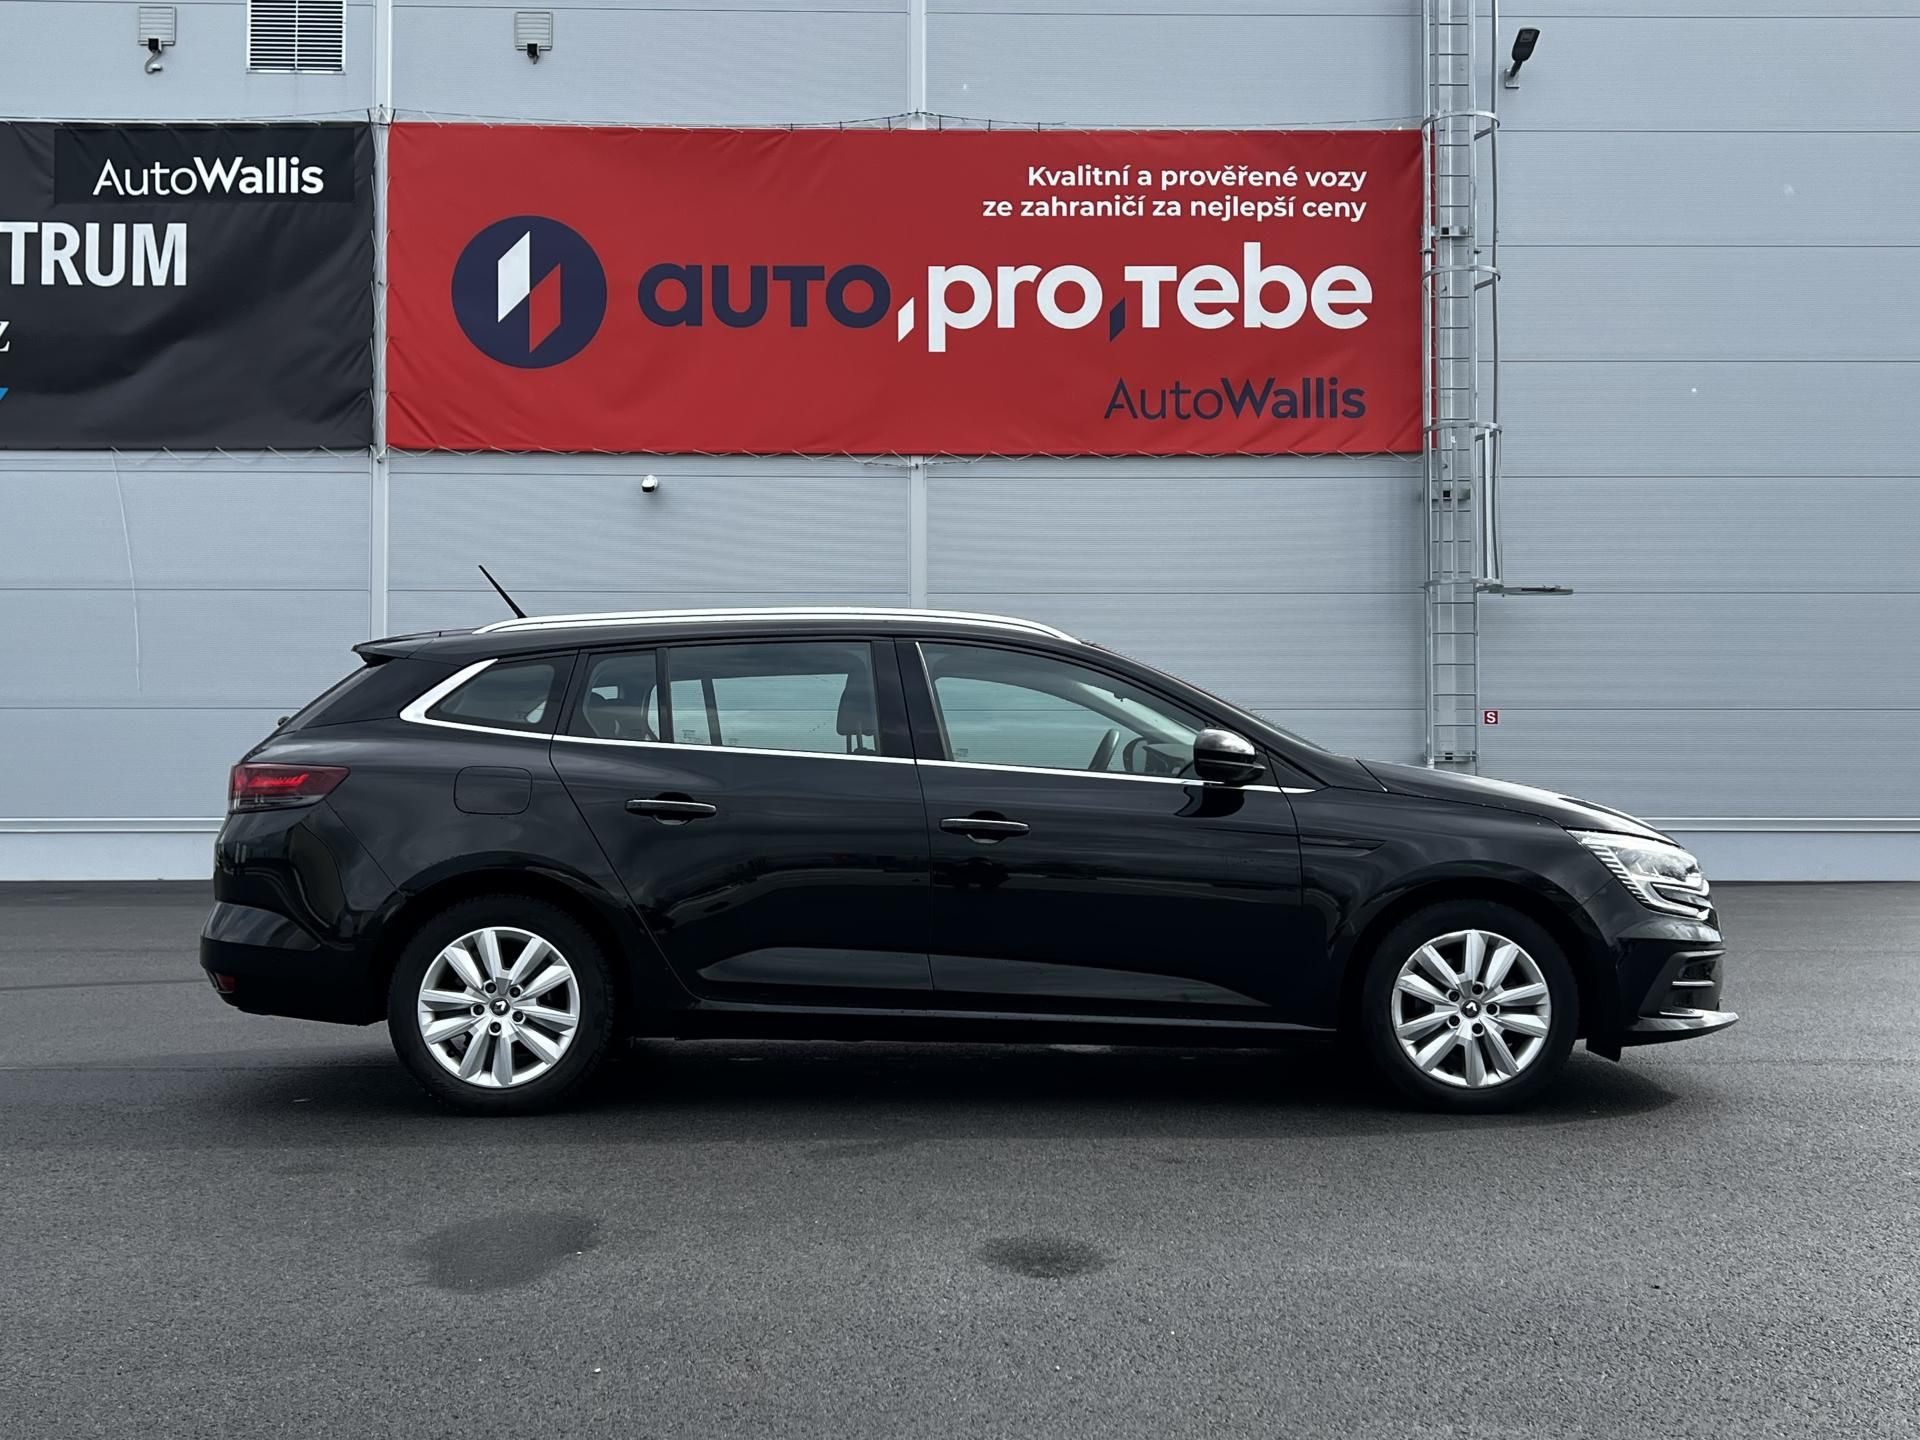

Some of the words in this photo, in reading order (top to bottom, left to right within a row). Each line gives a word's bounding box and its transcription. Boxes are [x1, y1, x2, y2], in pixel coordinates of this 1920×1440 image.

[92, 156, 324, 196] AutoWallis
[1028, 165, 1131, 187] Kvalitní
[1137, 171, 1152, 187] a
[1161, 165, 1299, 190] prověřené
[1305, 171, 1367, 192] vozy
[982, 200, 1013, 217] ze
[1020, 195, 1146, 217] zahraničí
[1152, 200, 1182, 217] za
[1190, 195, 1297, 222] nejlepší
[1302, 200, 1368, 222] ceny
[0, 221, 188, 287] TRUM
[1103, 376, 1367, 421] AutoWallis
[1486, 711, 1496, 723] S
